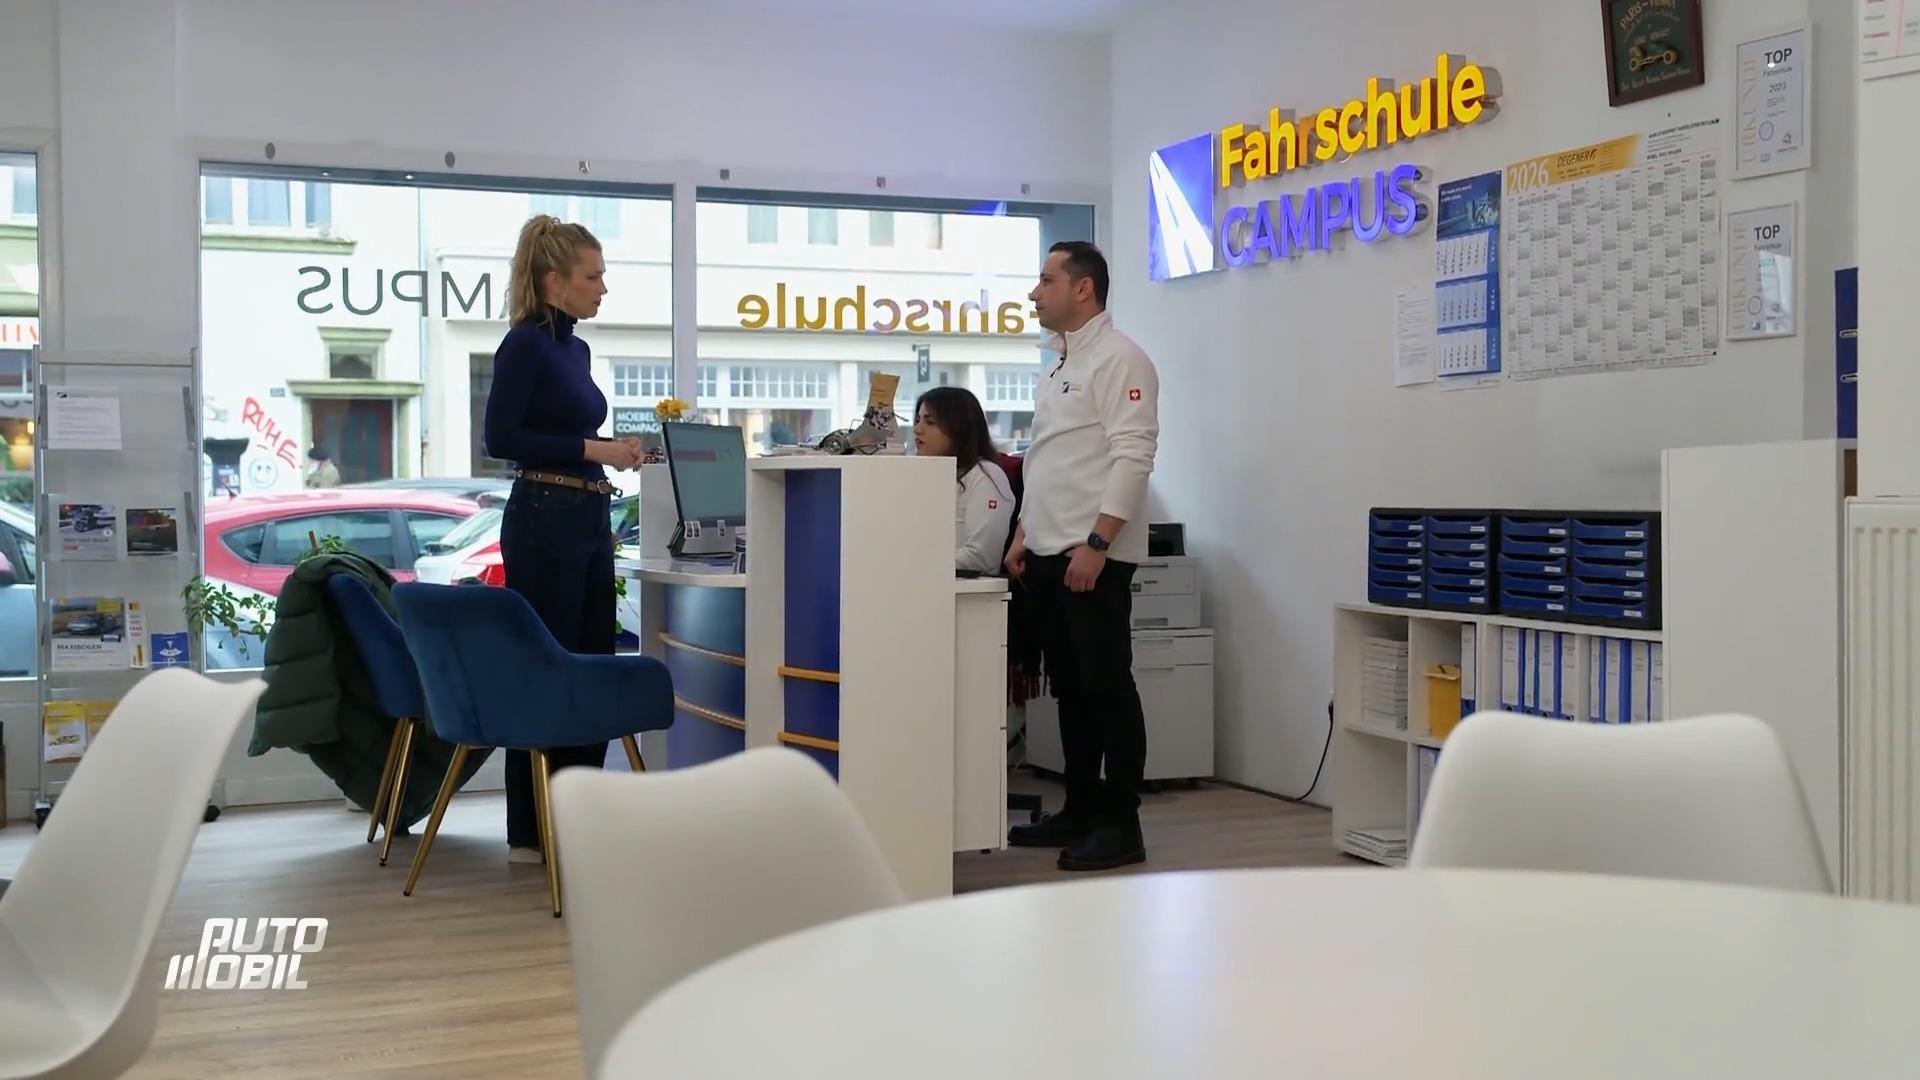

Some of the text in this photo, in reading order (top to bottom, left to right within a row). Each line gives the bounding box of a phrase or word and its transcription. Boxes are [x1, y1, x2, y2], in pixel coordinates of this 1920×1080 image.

[1764, 48, 1793, 65] TOP
[1220, 53, 1487, 188] Fahrschule
[1508, 158, 1549, 195] 2026
[1220, 164, 1419, 267] CAMPUS
[1754, 224, 1781, 240] TOP
[616, 422, 663, 433] COMPAG
